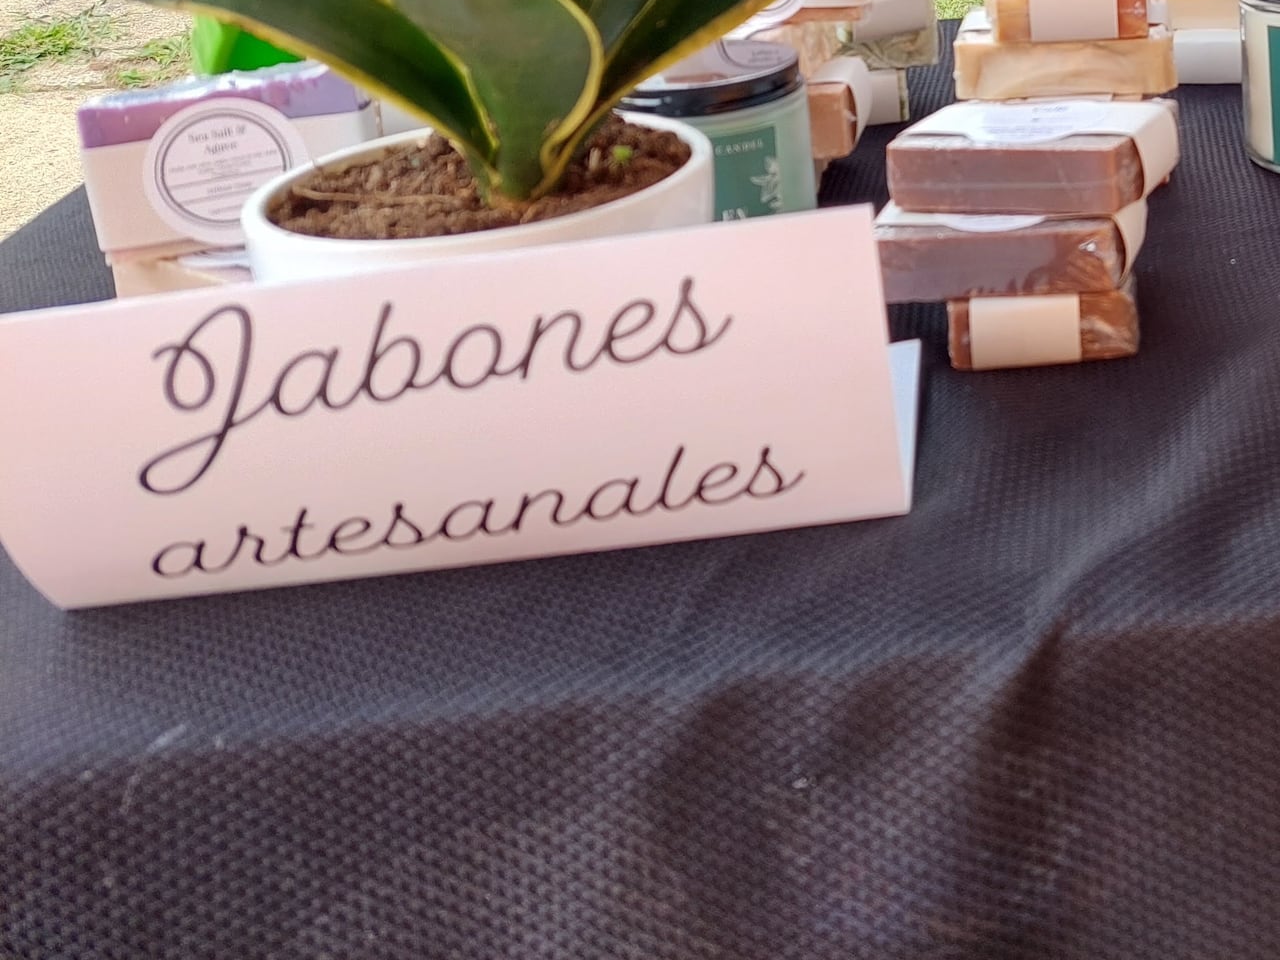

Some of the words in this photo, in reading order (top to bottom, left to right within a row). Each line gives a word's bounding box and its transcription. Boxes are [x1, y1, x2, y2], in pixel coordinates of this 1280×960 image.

[211, 127, 233, 139] Salt
[139, 276, 733, 496] Jabones
[150, 445, 806, 580] artesanales
